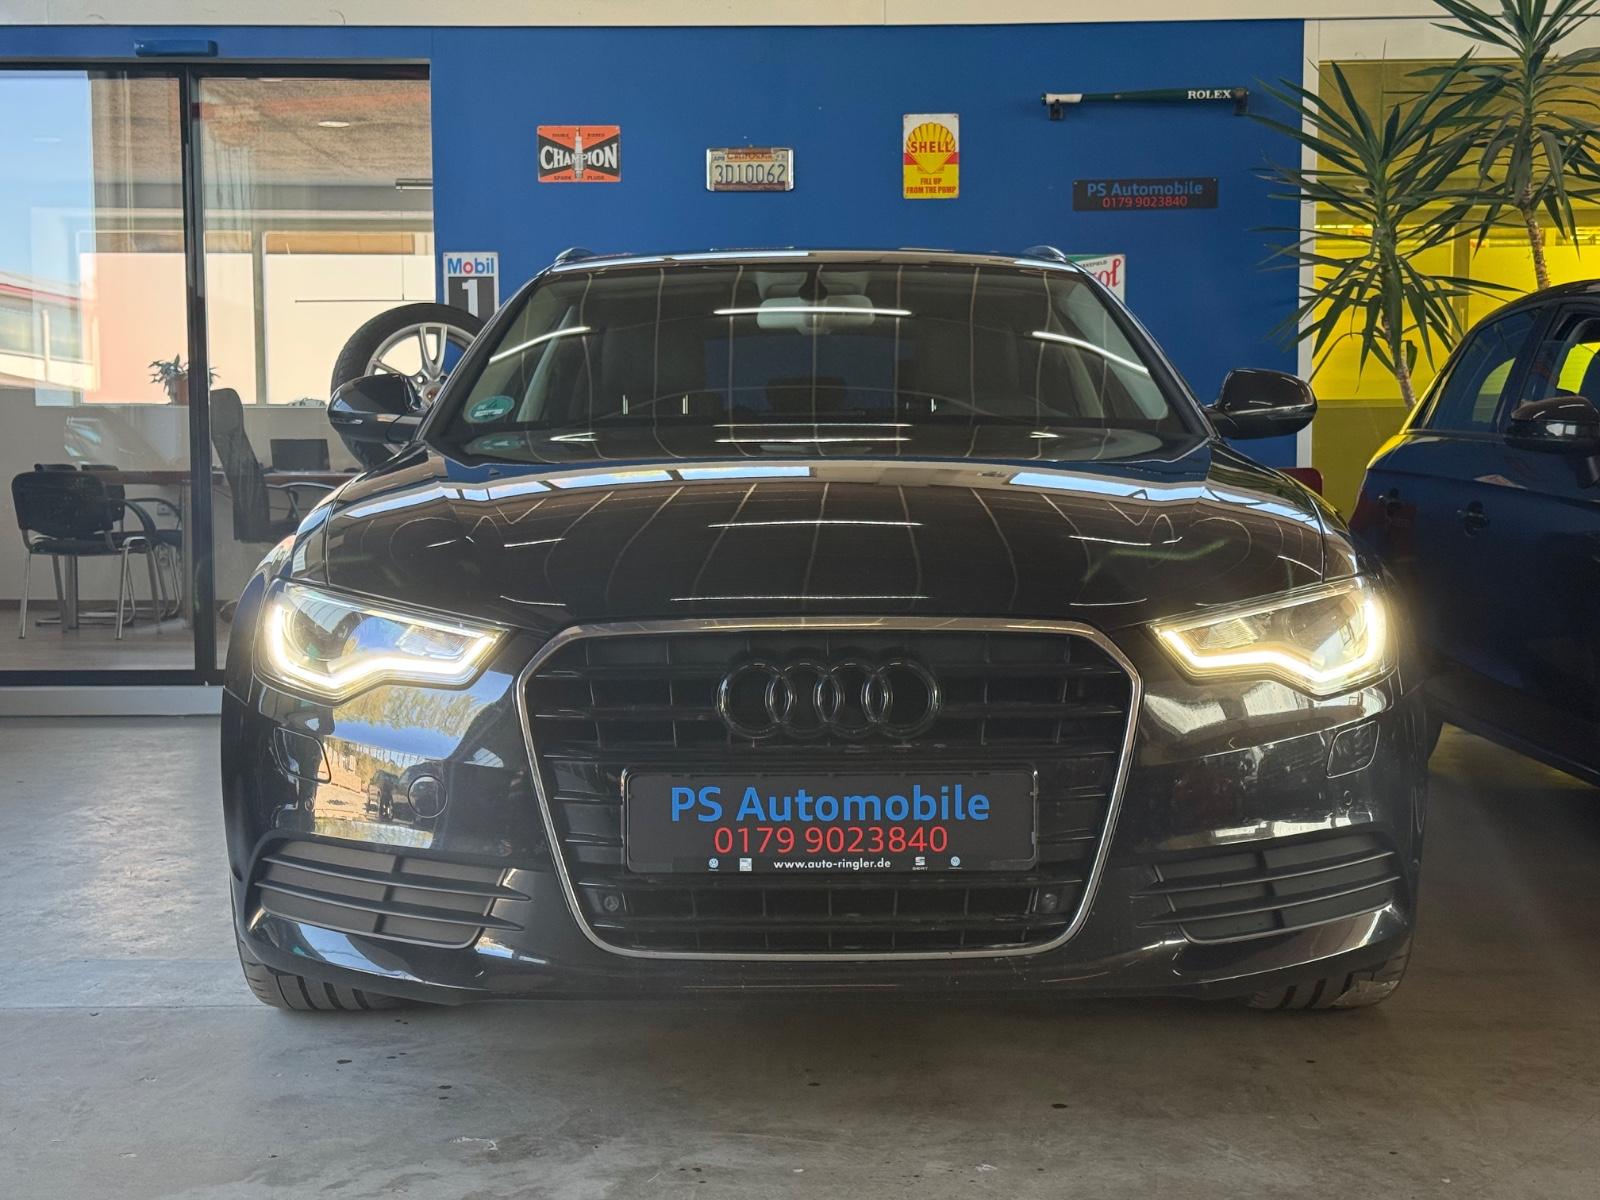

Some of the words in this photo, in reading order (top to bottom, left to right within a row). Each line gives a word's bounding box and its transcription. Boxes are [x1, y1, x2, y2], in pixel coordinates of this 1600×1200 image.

[1187, 89, 1231, 99] ROLEX
[910, 141, 951, 153] SHELL
[540, 143, 618, 170] CHAMPION
[714, 163, 786, 184] 3D10062
[933, 177, 942, 186] UP
[906, 186, 924, 194] FROM
[925, 186, 937, 194] THE
[1087, 183, 1107, 197] PS
[1111, 180, 1203, 196] Automobile
[1102, 197, 1133, 208] 0179
[1135, 196, 1188, 208] 9023840
[447, 258, 495, 275] Mobil
[462, 279, 479, 318] 1
[671, 787, 723, 822] PS
[736, 784, 991, 822] Automobile
[714, 827, 795, 854] 0179
[805, 826, 949, 854] 9023840
[773, 858, 891, 871] www.auto-ringler.de
